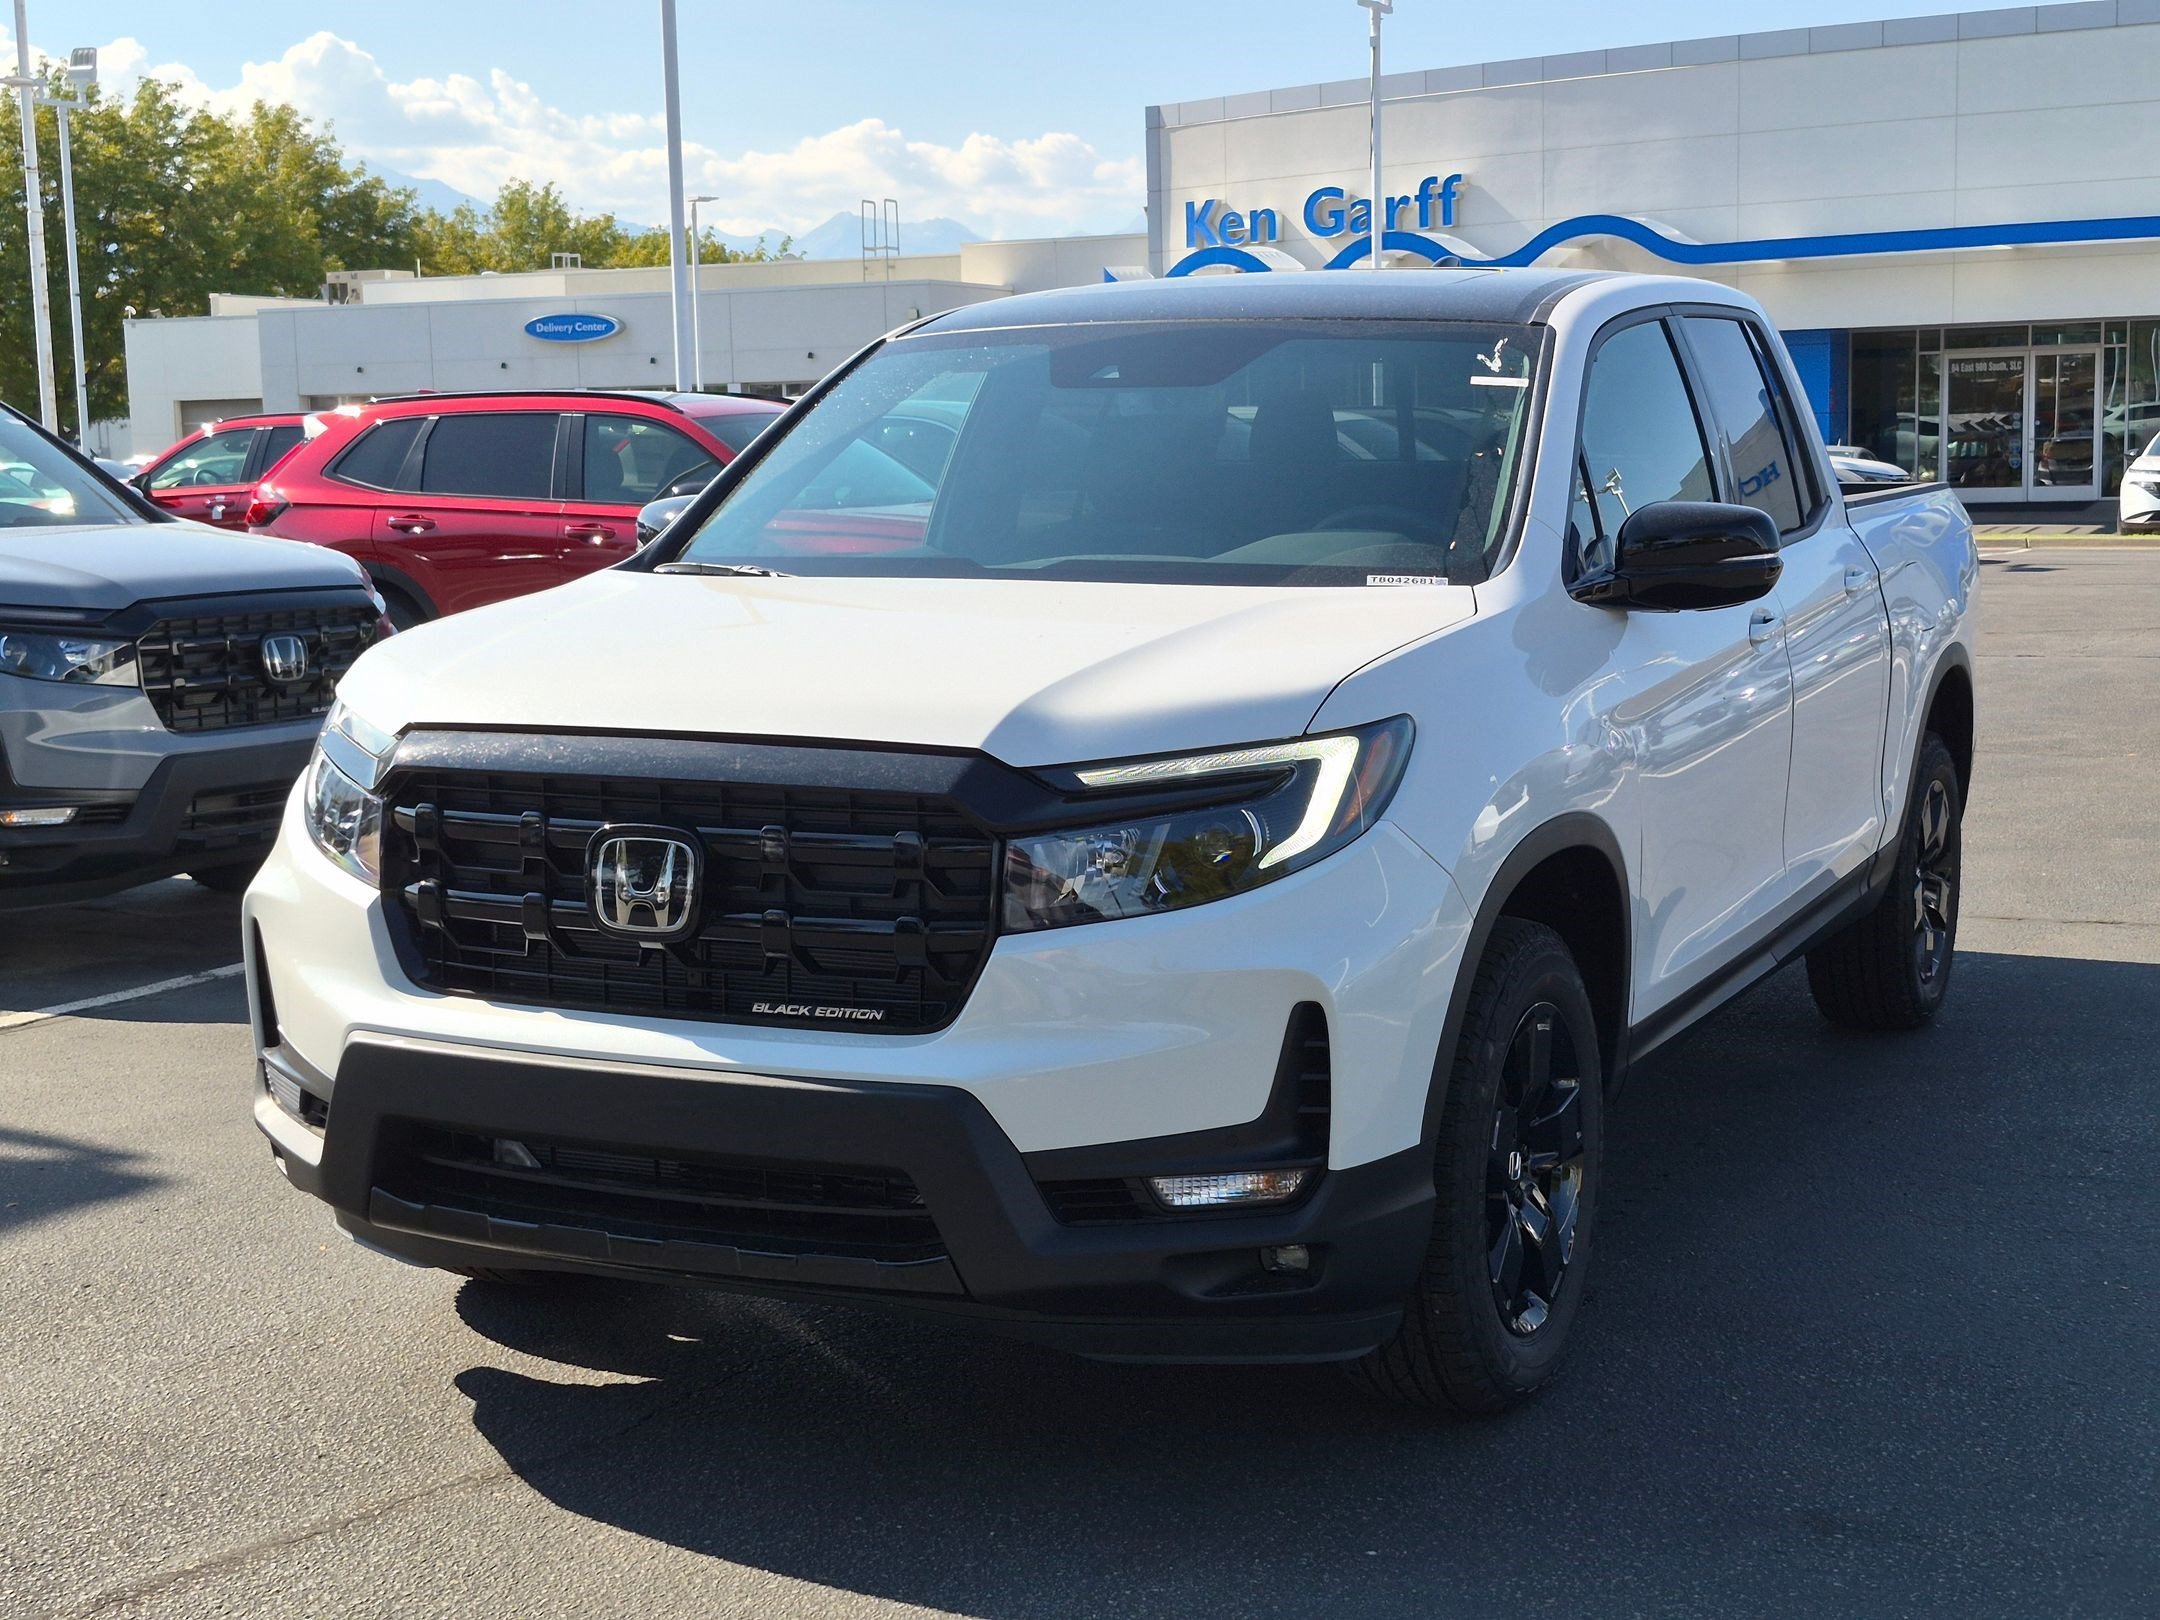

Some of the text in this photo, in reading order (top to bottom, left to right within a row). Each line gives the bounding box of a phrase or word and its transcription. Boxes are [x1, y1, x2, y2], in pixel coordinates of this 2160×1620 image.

[1184, 172, 1463, 249] Ken Garff
[536, 321, 607, 334] Delivery Center
[2010, 359, 2023, 371] SLC
[752, 1002, 884, 1021] BLACK EDITION
